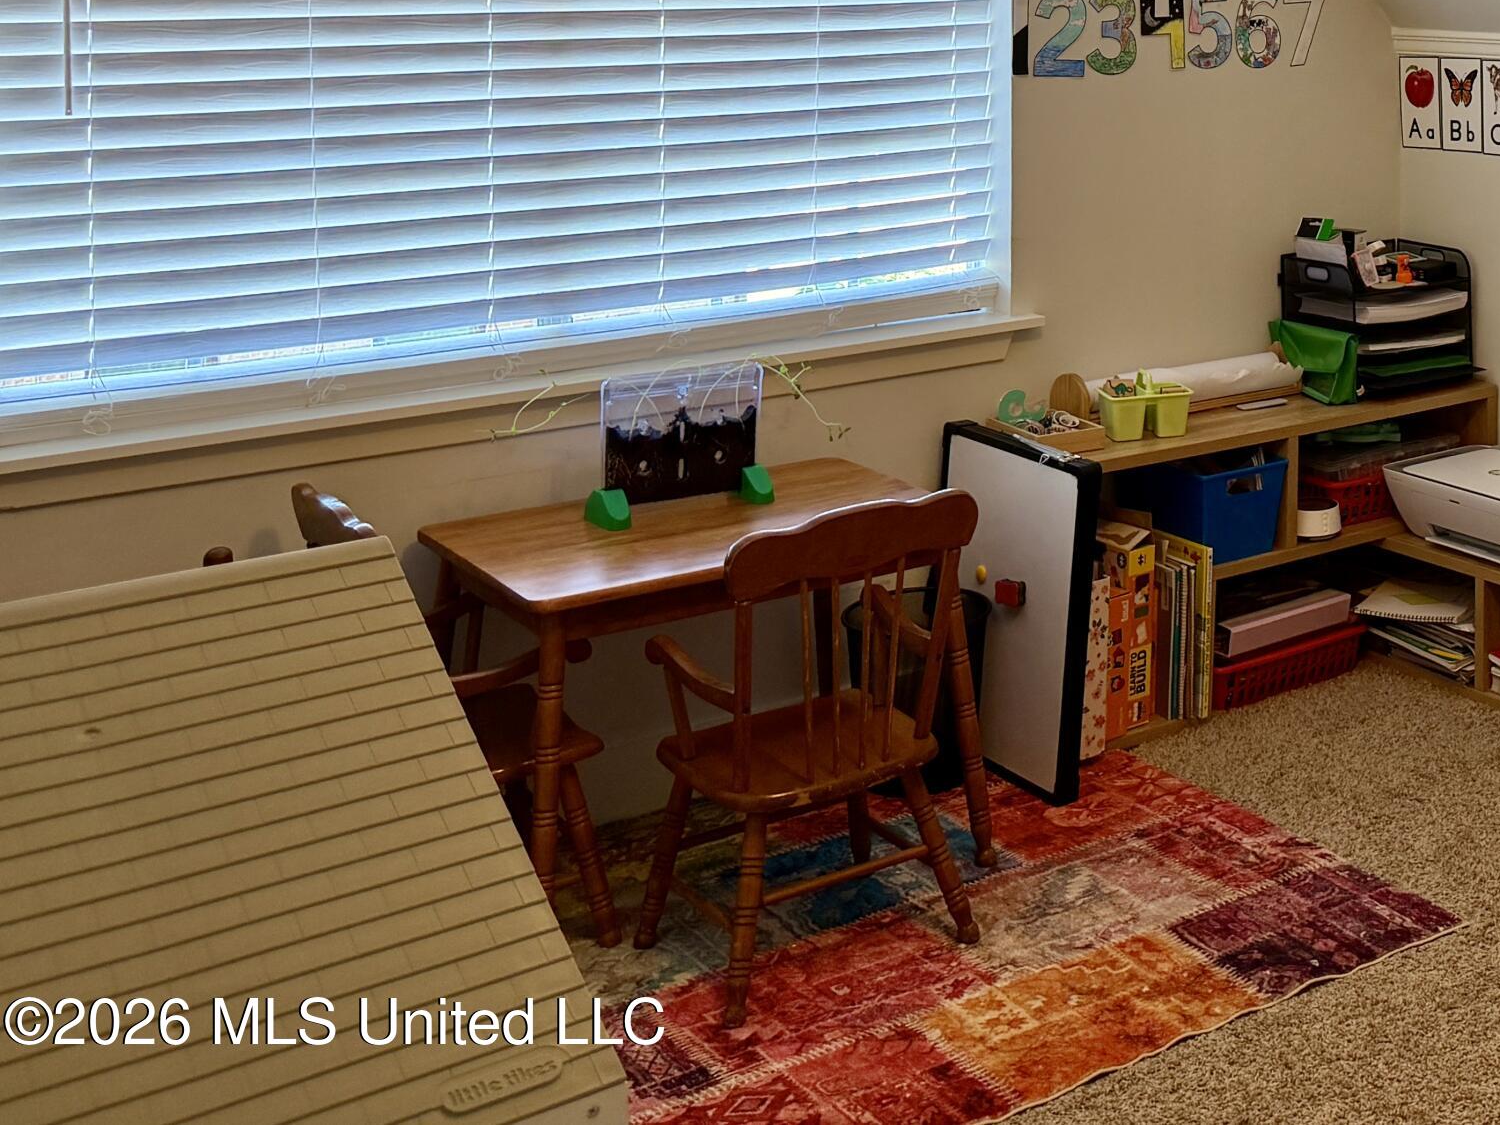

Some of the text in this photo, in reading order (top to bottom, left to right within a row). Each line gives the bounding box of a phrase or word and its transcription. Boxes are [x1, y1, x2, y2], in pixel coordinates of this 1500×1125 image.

[1129, 652, 1138, 696] LEARN TO
[1138, 649, 1147, 695] BUILD
[447, 1060, 557, 1107] little tikes
